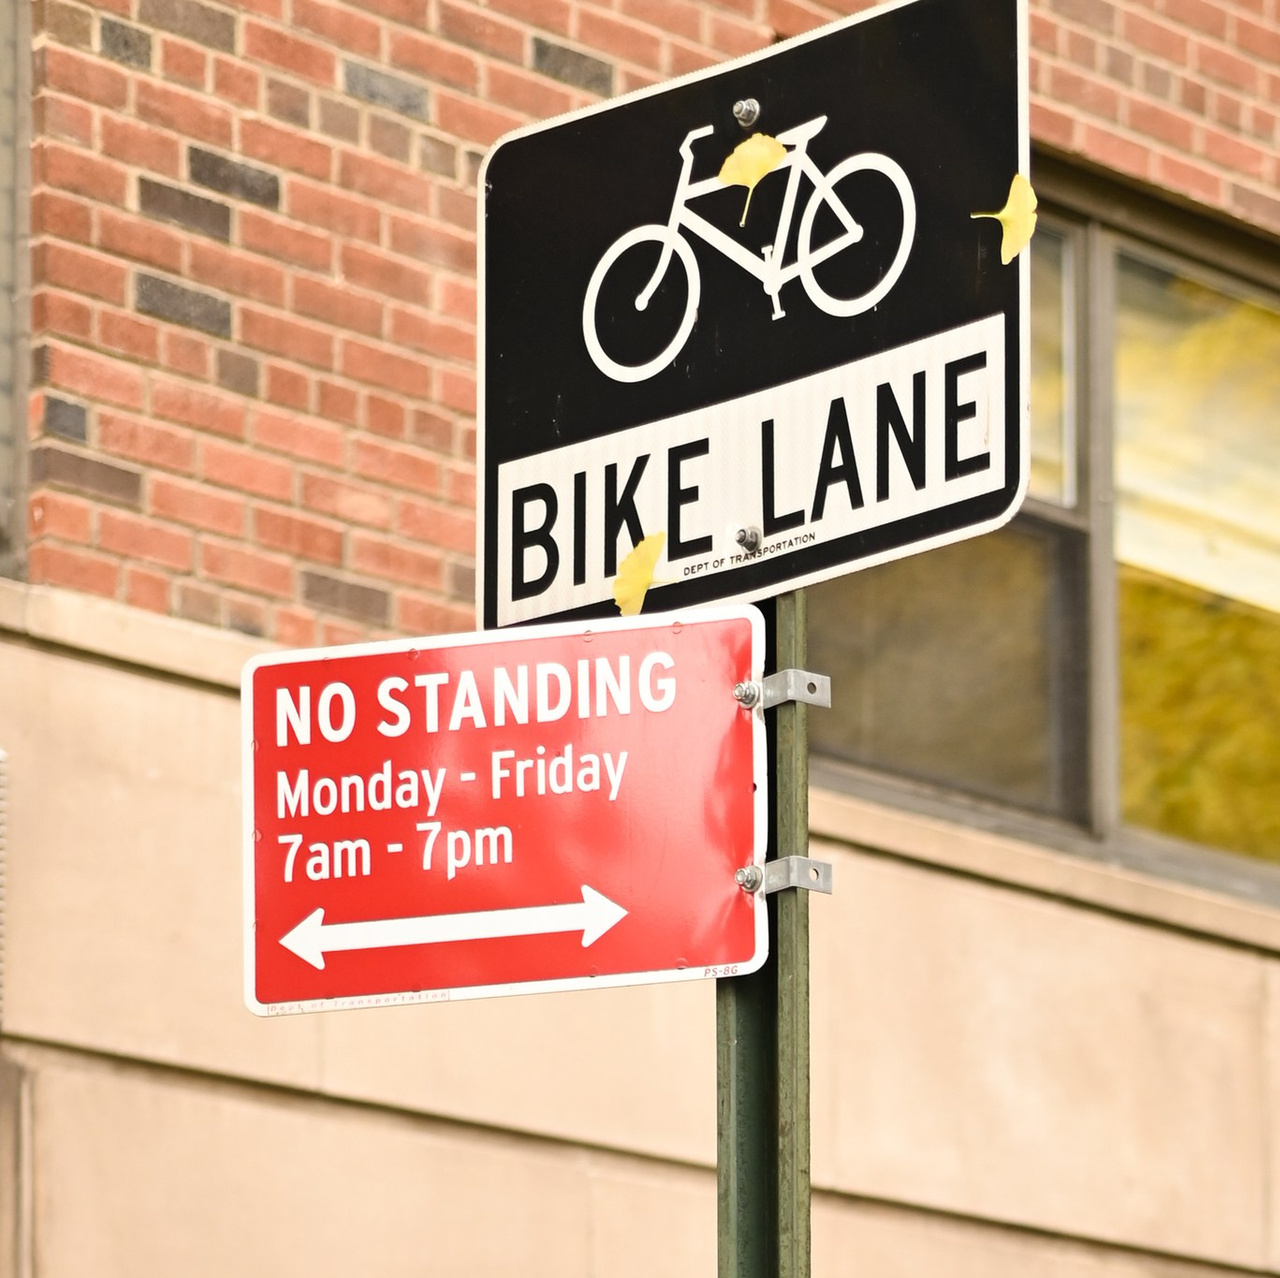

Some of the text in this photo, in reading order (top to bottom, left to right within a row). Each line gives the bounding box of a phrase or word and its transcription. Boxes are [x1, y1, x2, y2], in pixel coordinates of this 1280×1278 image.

[511, 350, 991, 602] BIKE LANE
[684, 532, 816, 576] DEPT OF TRANSPORTATION
[275, 651, 677, 747] NO STANDING
[277, 743, 629, 819] Monday - Friday
[277, 820, 513, 882] 7am - 7pm
[704, 965, 738, 977] PS-8G
